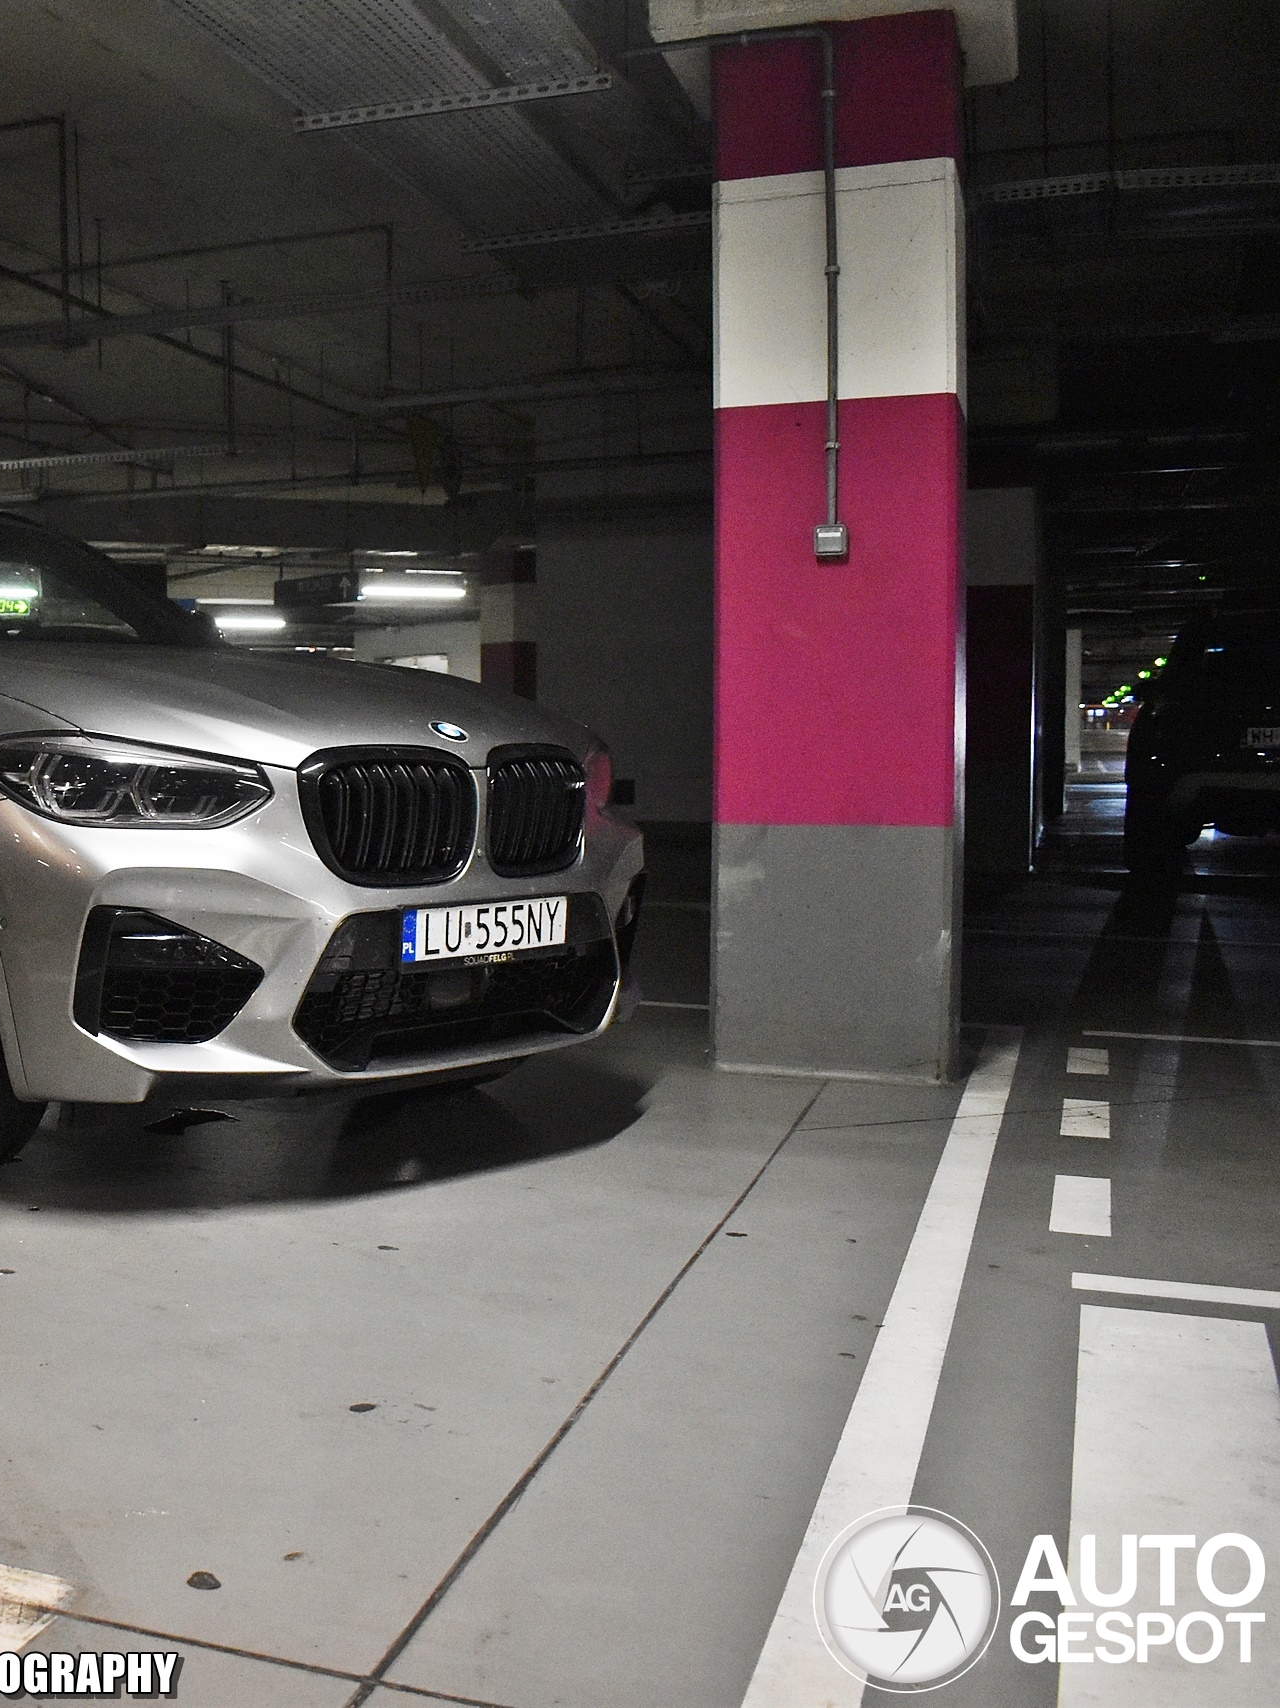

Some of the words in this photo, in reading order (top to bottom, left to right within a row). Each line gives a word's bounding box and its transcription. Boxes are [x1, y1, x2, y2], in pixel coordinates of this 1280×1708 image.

[425, 910, 463, 956] LU
[475, 901, 560, 949] 555NY
[402, 942, 414, 954] PL
